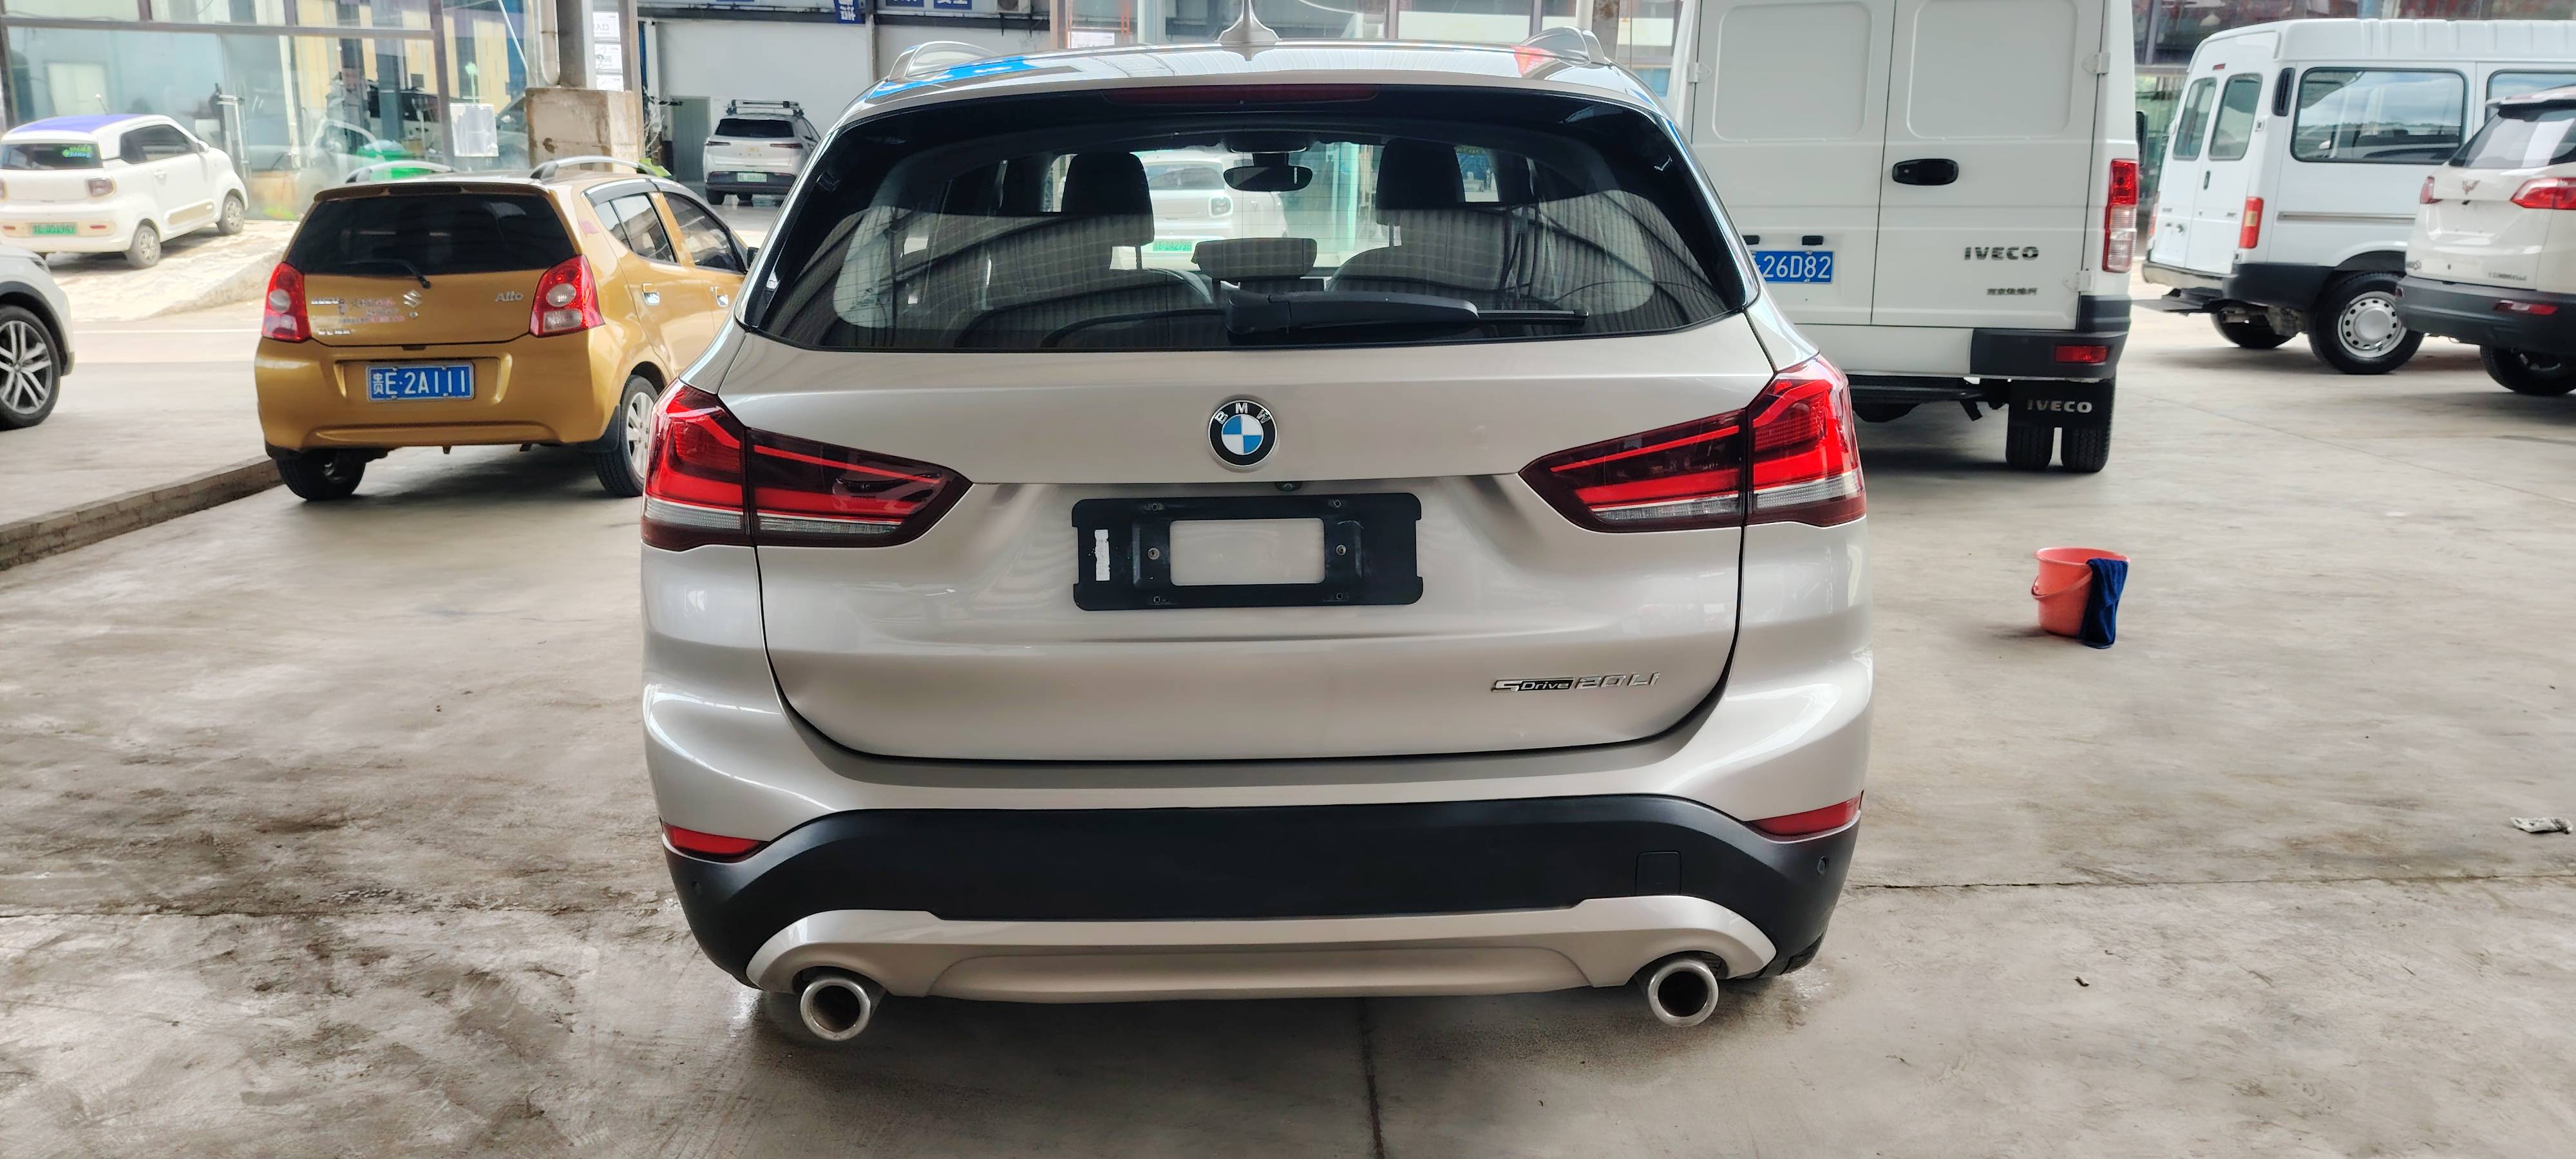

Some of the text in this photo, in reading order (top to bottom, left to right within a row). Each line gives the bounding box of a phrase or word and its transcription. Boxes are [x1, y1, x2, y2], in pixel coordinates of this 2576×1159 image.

[1965, 247, 2039, 260] IVECO
[1752, 255, 1831, 278] 26D82
[495, 291, 524, 302] Alto
[2027, 400, 2092, 413] IVECO
[1214, 402, 1271, 425] BMW
